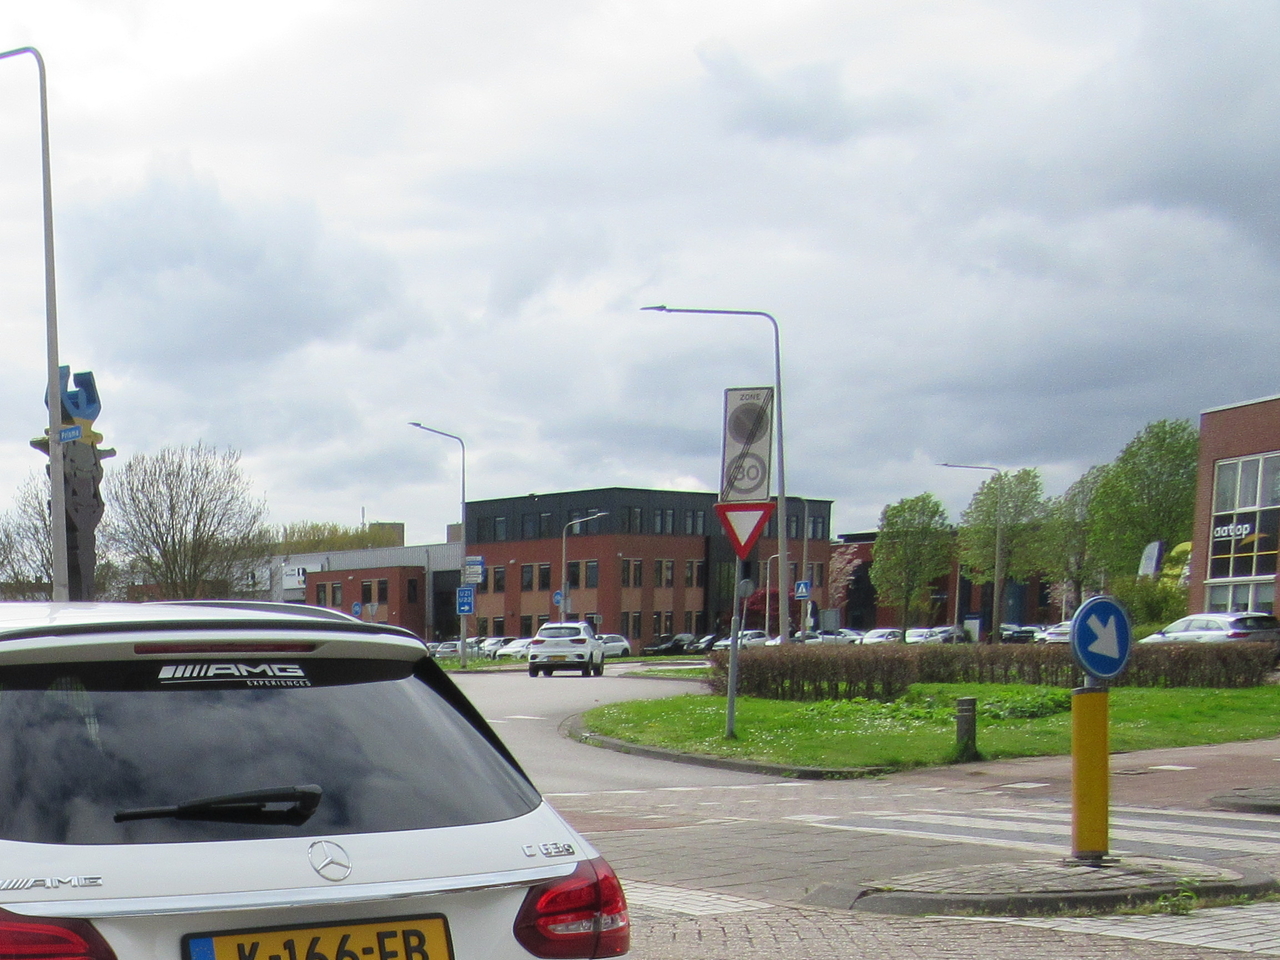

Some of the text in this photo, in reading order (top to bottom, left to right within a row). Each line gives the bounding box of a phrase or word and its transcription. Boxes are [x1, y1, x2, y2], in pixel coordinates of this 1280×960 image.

[734, 464, 759, 481] 30
[206, 664, 305, 677] AMG
[24, 875, 103, 890] AMG
